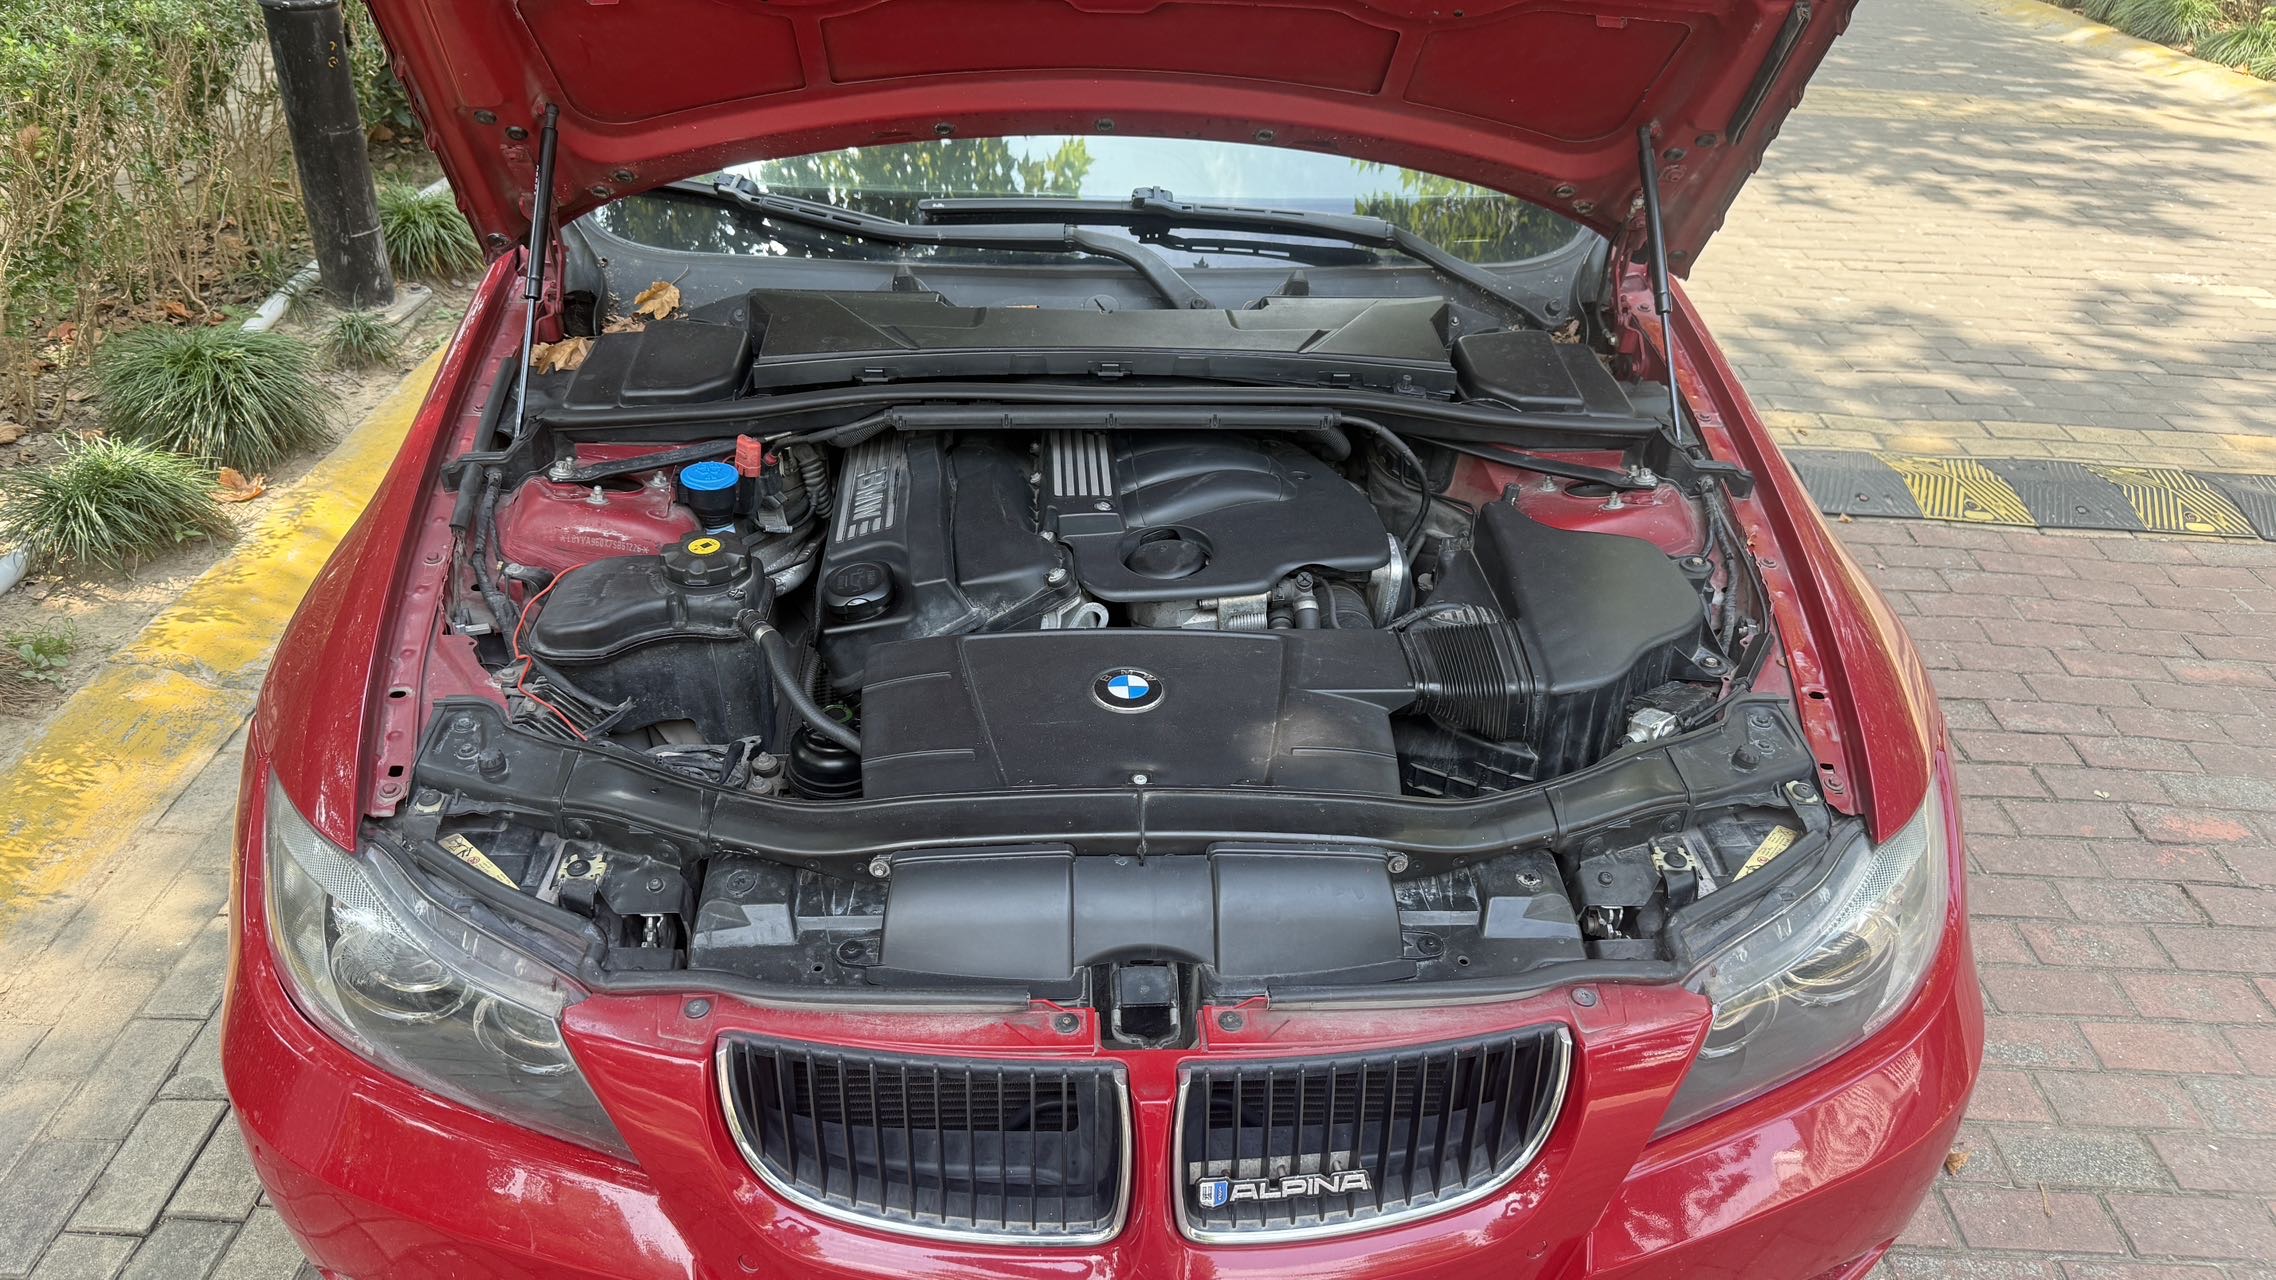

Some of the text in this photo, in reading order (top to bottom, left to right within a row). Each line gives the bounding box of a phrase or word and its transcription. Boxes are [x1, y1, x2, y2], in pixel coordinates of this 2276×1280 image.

[853, 467, 887, 521] BMW
[1100, 669, 1157, 682] BMW
[1229, 1173, 1368, 1202] ALPINA
